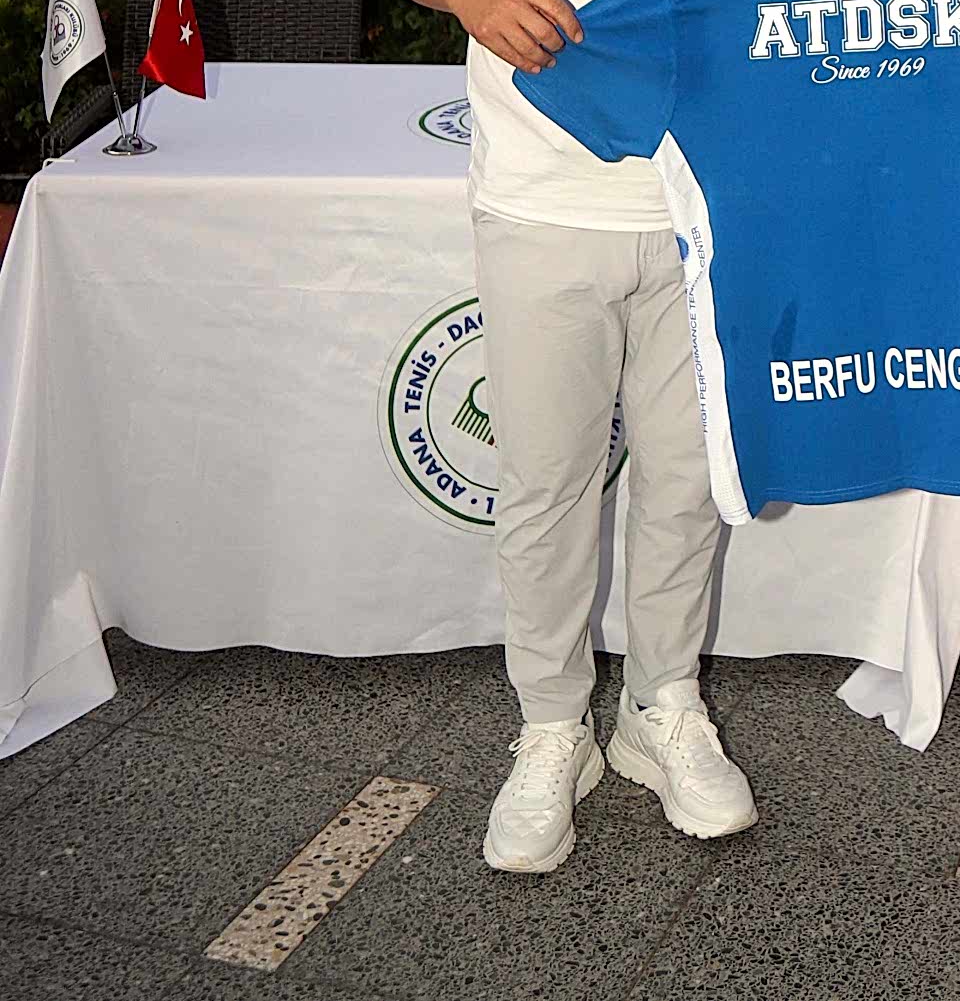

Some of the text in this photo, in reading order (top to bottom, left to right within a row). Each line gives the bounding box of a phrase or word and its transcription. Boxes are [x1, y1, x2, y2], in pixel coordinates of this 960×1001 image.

[810, 55, 926, 84] Since 1969
[690, 226, 706, 268] CENTER
[404, 349, 438, 413] TENİS
[689, 313, 708, 400] PERFORMANCE
[770, 351, 876, 402] BERFU
[407, 426, 467, 499] ADANA
